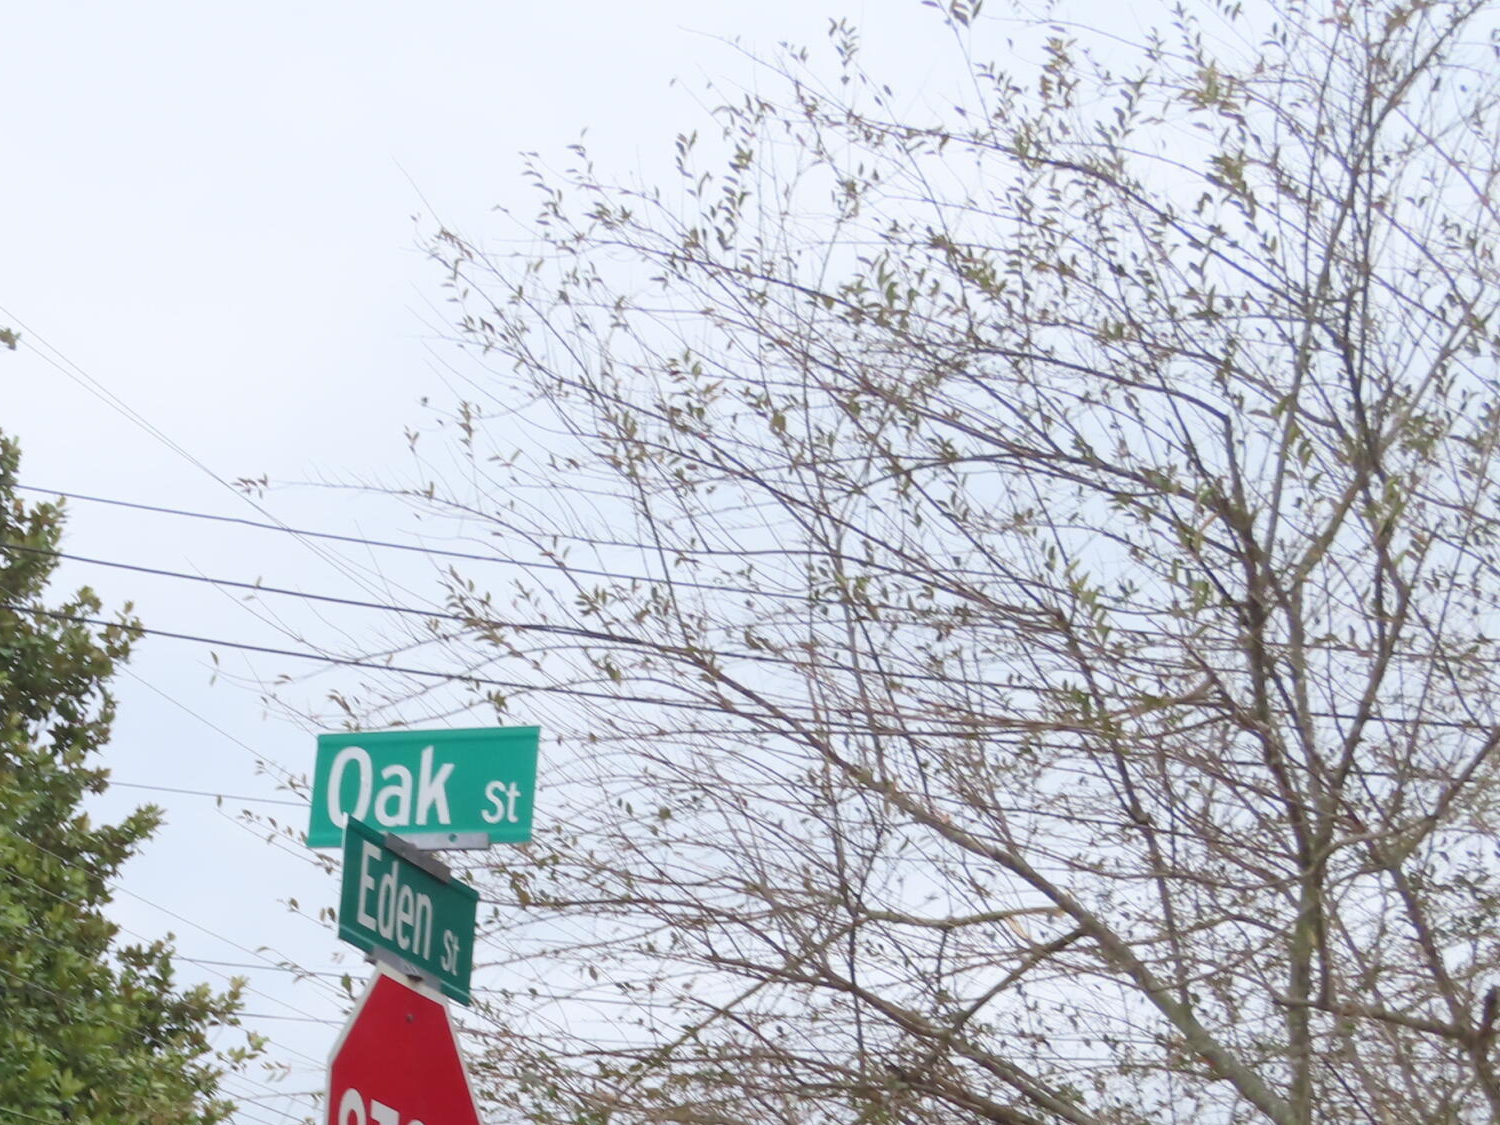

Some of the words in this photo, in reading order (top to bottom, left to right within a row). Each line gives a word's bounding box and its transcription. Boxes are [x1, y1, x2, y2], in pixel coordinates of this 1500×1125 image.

[326, 745, 455, 829] Oak
[481, 780, 521, 824] St
[356, 840, 433, 960] Eden
[440, 929, 460, 976] St
